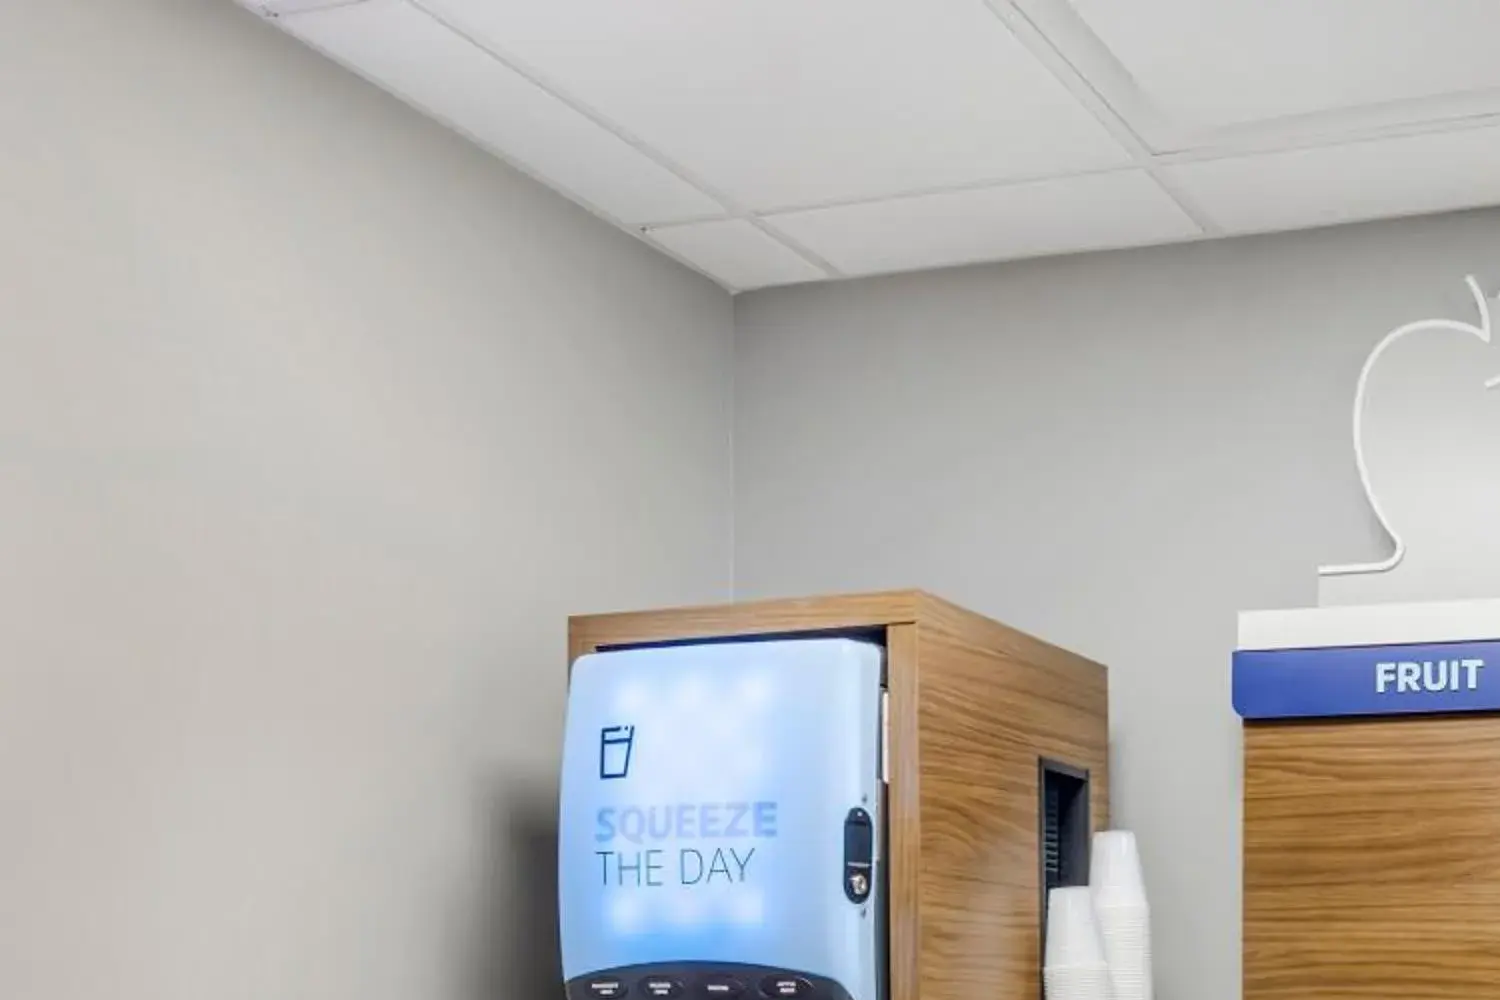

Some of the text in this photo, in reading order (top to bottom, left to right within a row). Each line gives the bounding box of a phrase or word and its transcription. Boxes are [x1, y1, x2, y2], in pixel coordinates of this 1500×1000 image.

[1375, 659, 1484, 693] FRUIT
[595, 801, 778, 844] SQUEEZE
[595, 847, 756, 887] THE DAY
